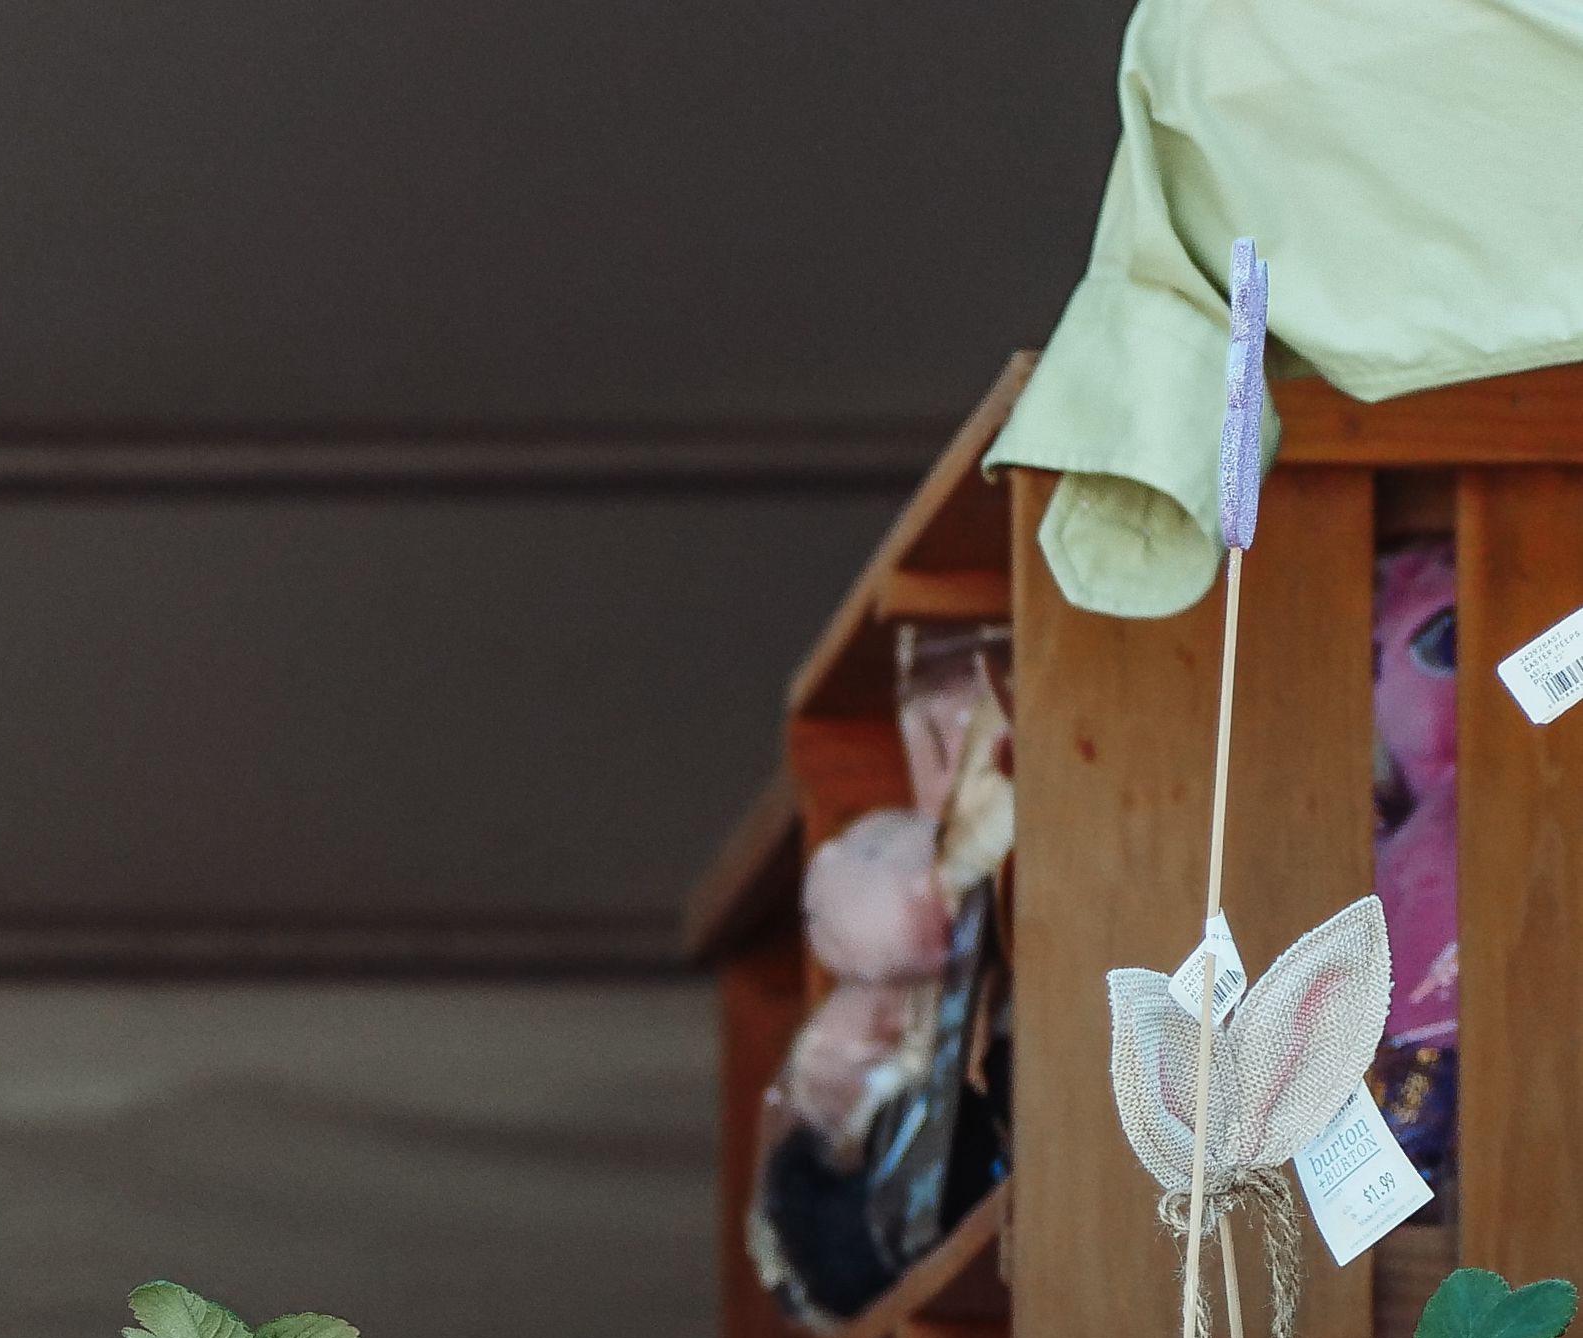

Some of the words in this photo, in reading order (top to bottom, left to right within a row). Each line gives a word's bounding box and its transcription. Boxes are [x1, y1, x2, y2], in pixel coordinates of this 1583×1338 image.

[1523, 648, 1552, 672] EASTER
[1309, 1118, 1371, 1177] burton
[1318, 1134, 1379, 1189] +BURTON
[1363, 1171, 1396, 1204] $1.99
